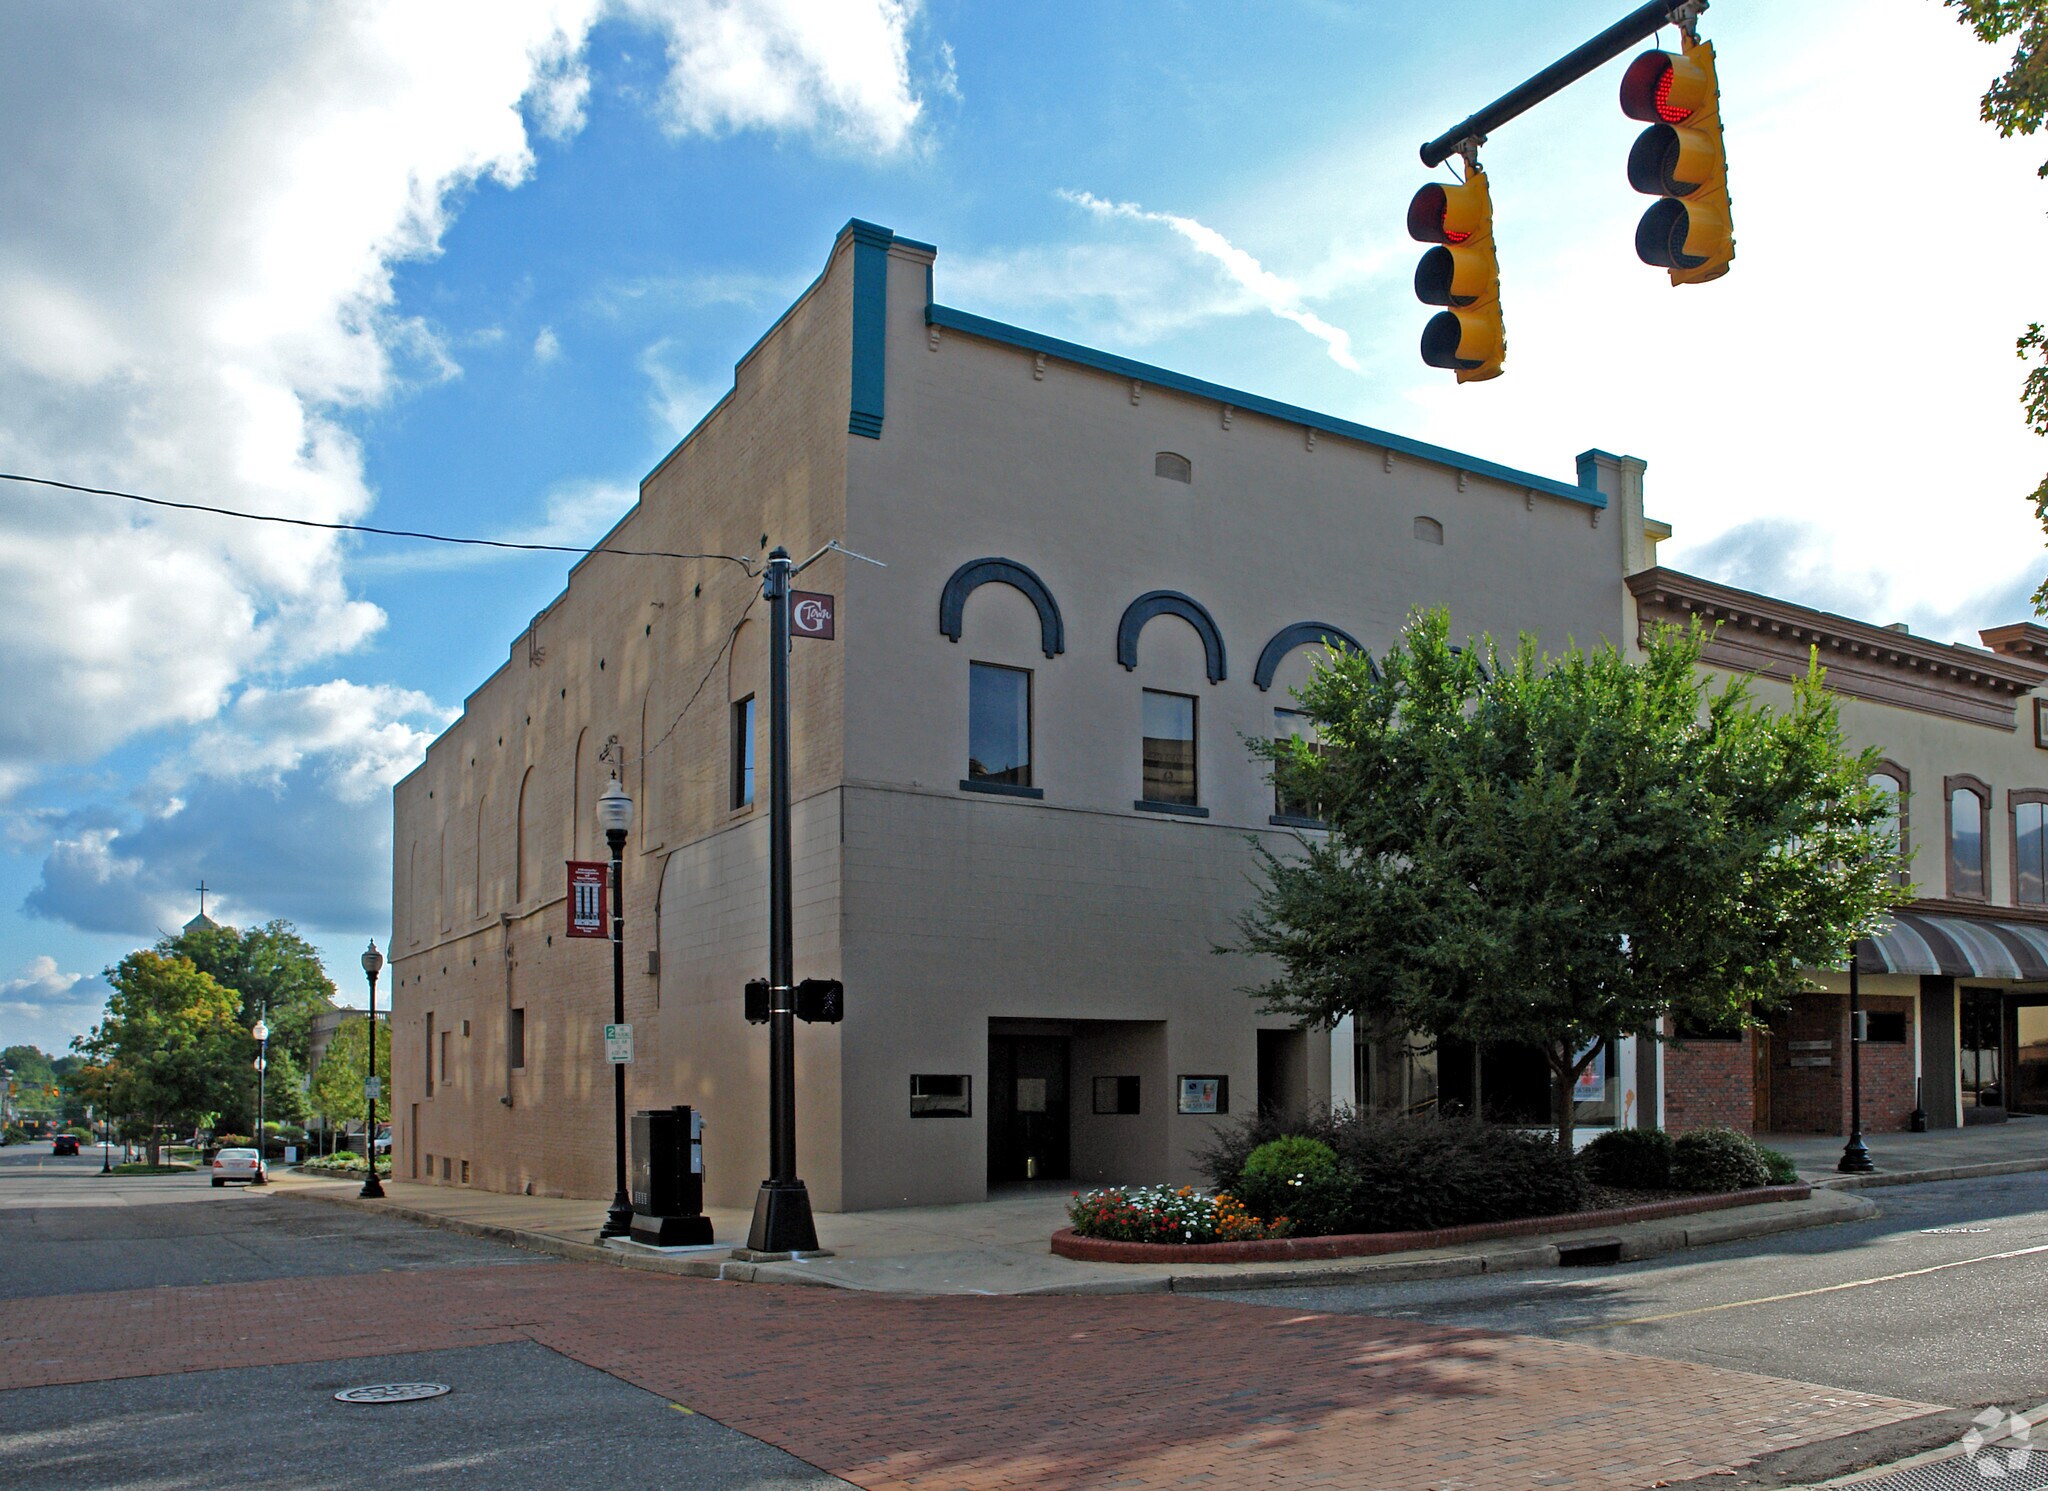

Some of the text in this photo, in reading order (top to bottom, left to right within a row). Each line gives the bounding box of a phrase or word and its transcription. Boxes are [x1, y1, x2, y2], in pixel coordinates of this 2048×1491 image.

[794, 600, 831, 631] G Town
[608, 1028, 614, 1037] 2
